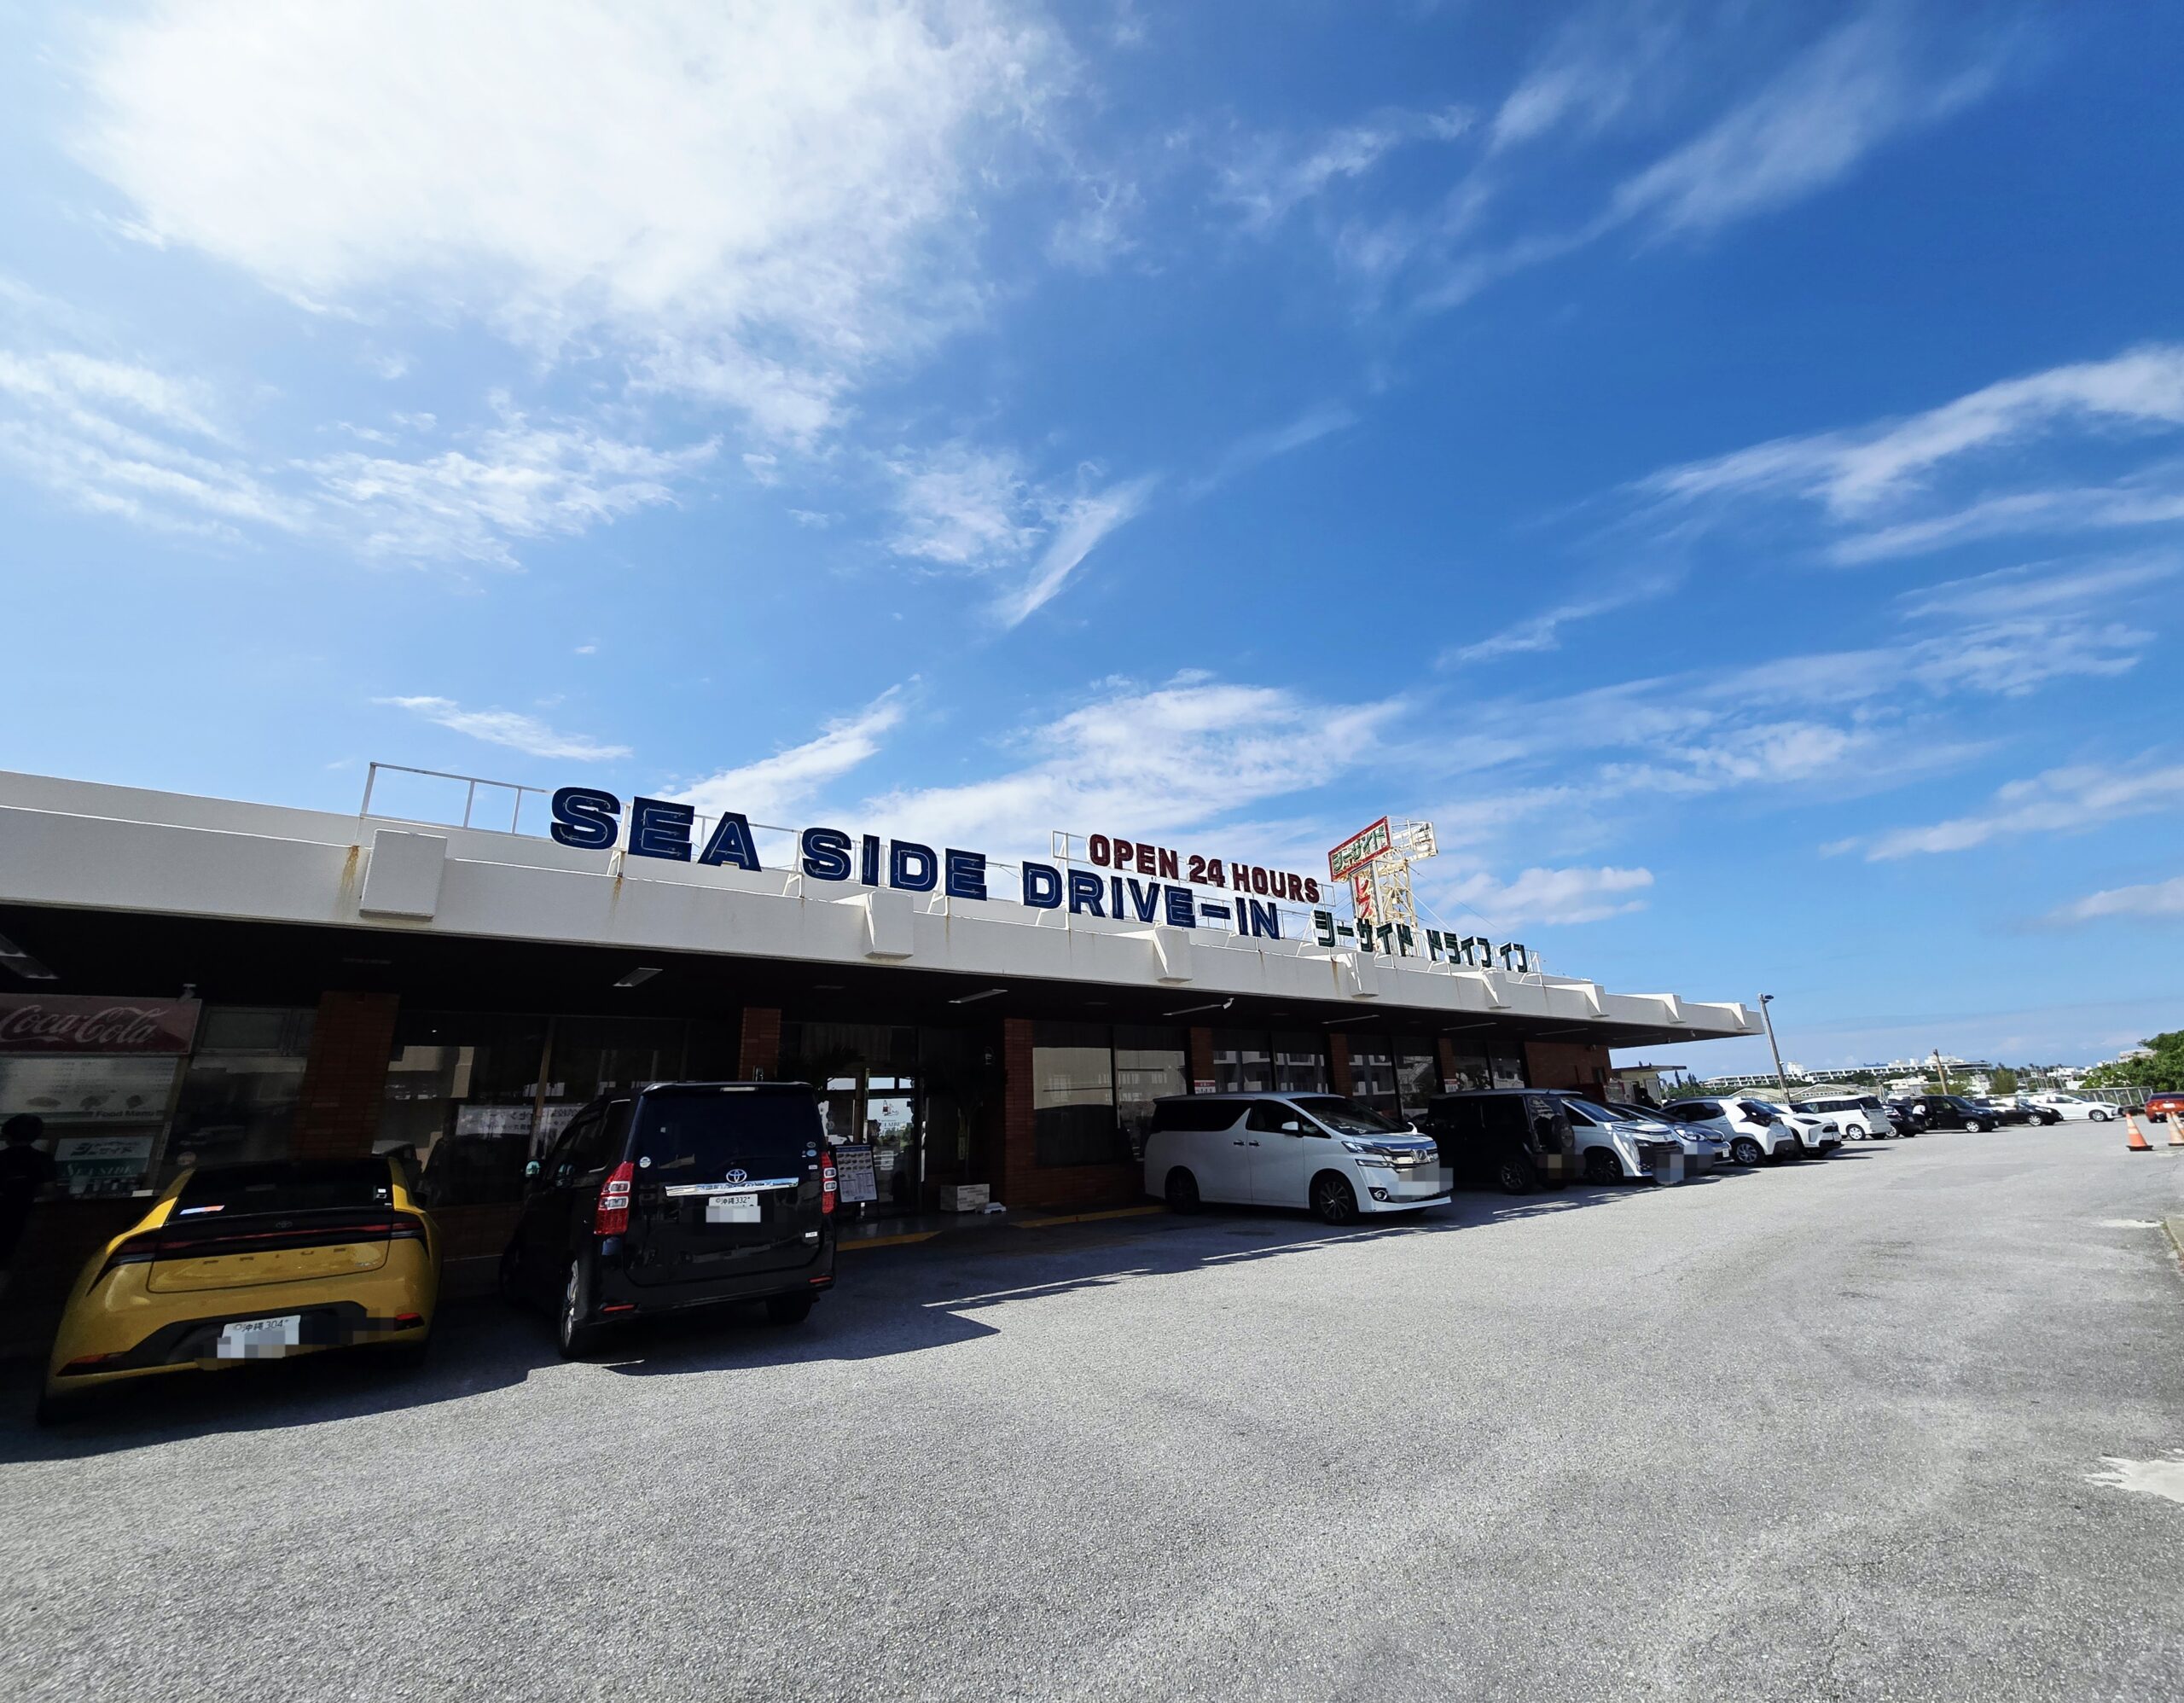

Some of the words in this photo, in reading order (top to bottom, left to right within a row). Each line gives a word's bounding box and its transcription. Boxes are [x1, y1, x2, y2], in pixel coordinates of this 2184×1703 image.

[550, 786, 762, 873] SEA
[801, 827, 988, 902] SIDE
[1022, 861, 1281, 940] DRIVE-IN
[1088, 833, 1181, 880] OPEN
[1188, 854, 1225, 887] 24
[1232, 862, 1321, 904] HOURS
[1313, 909, 1414, 957] シーサイド
[0, 1004, 170, 1043] Coca-Cola
[265, 1319, 284, 1330] 304
